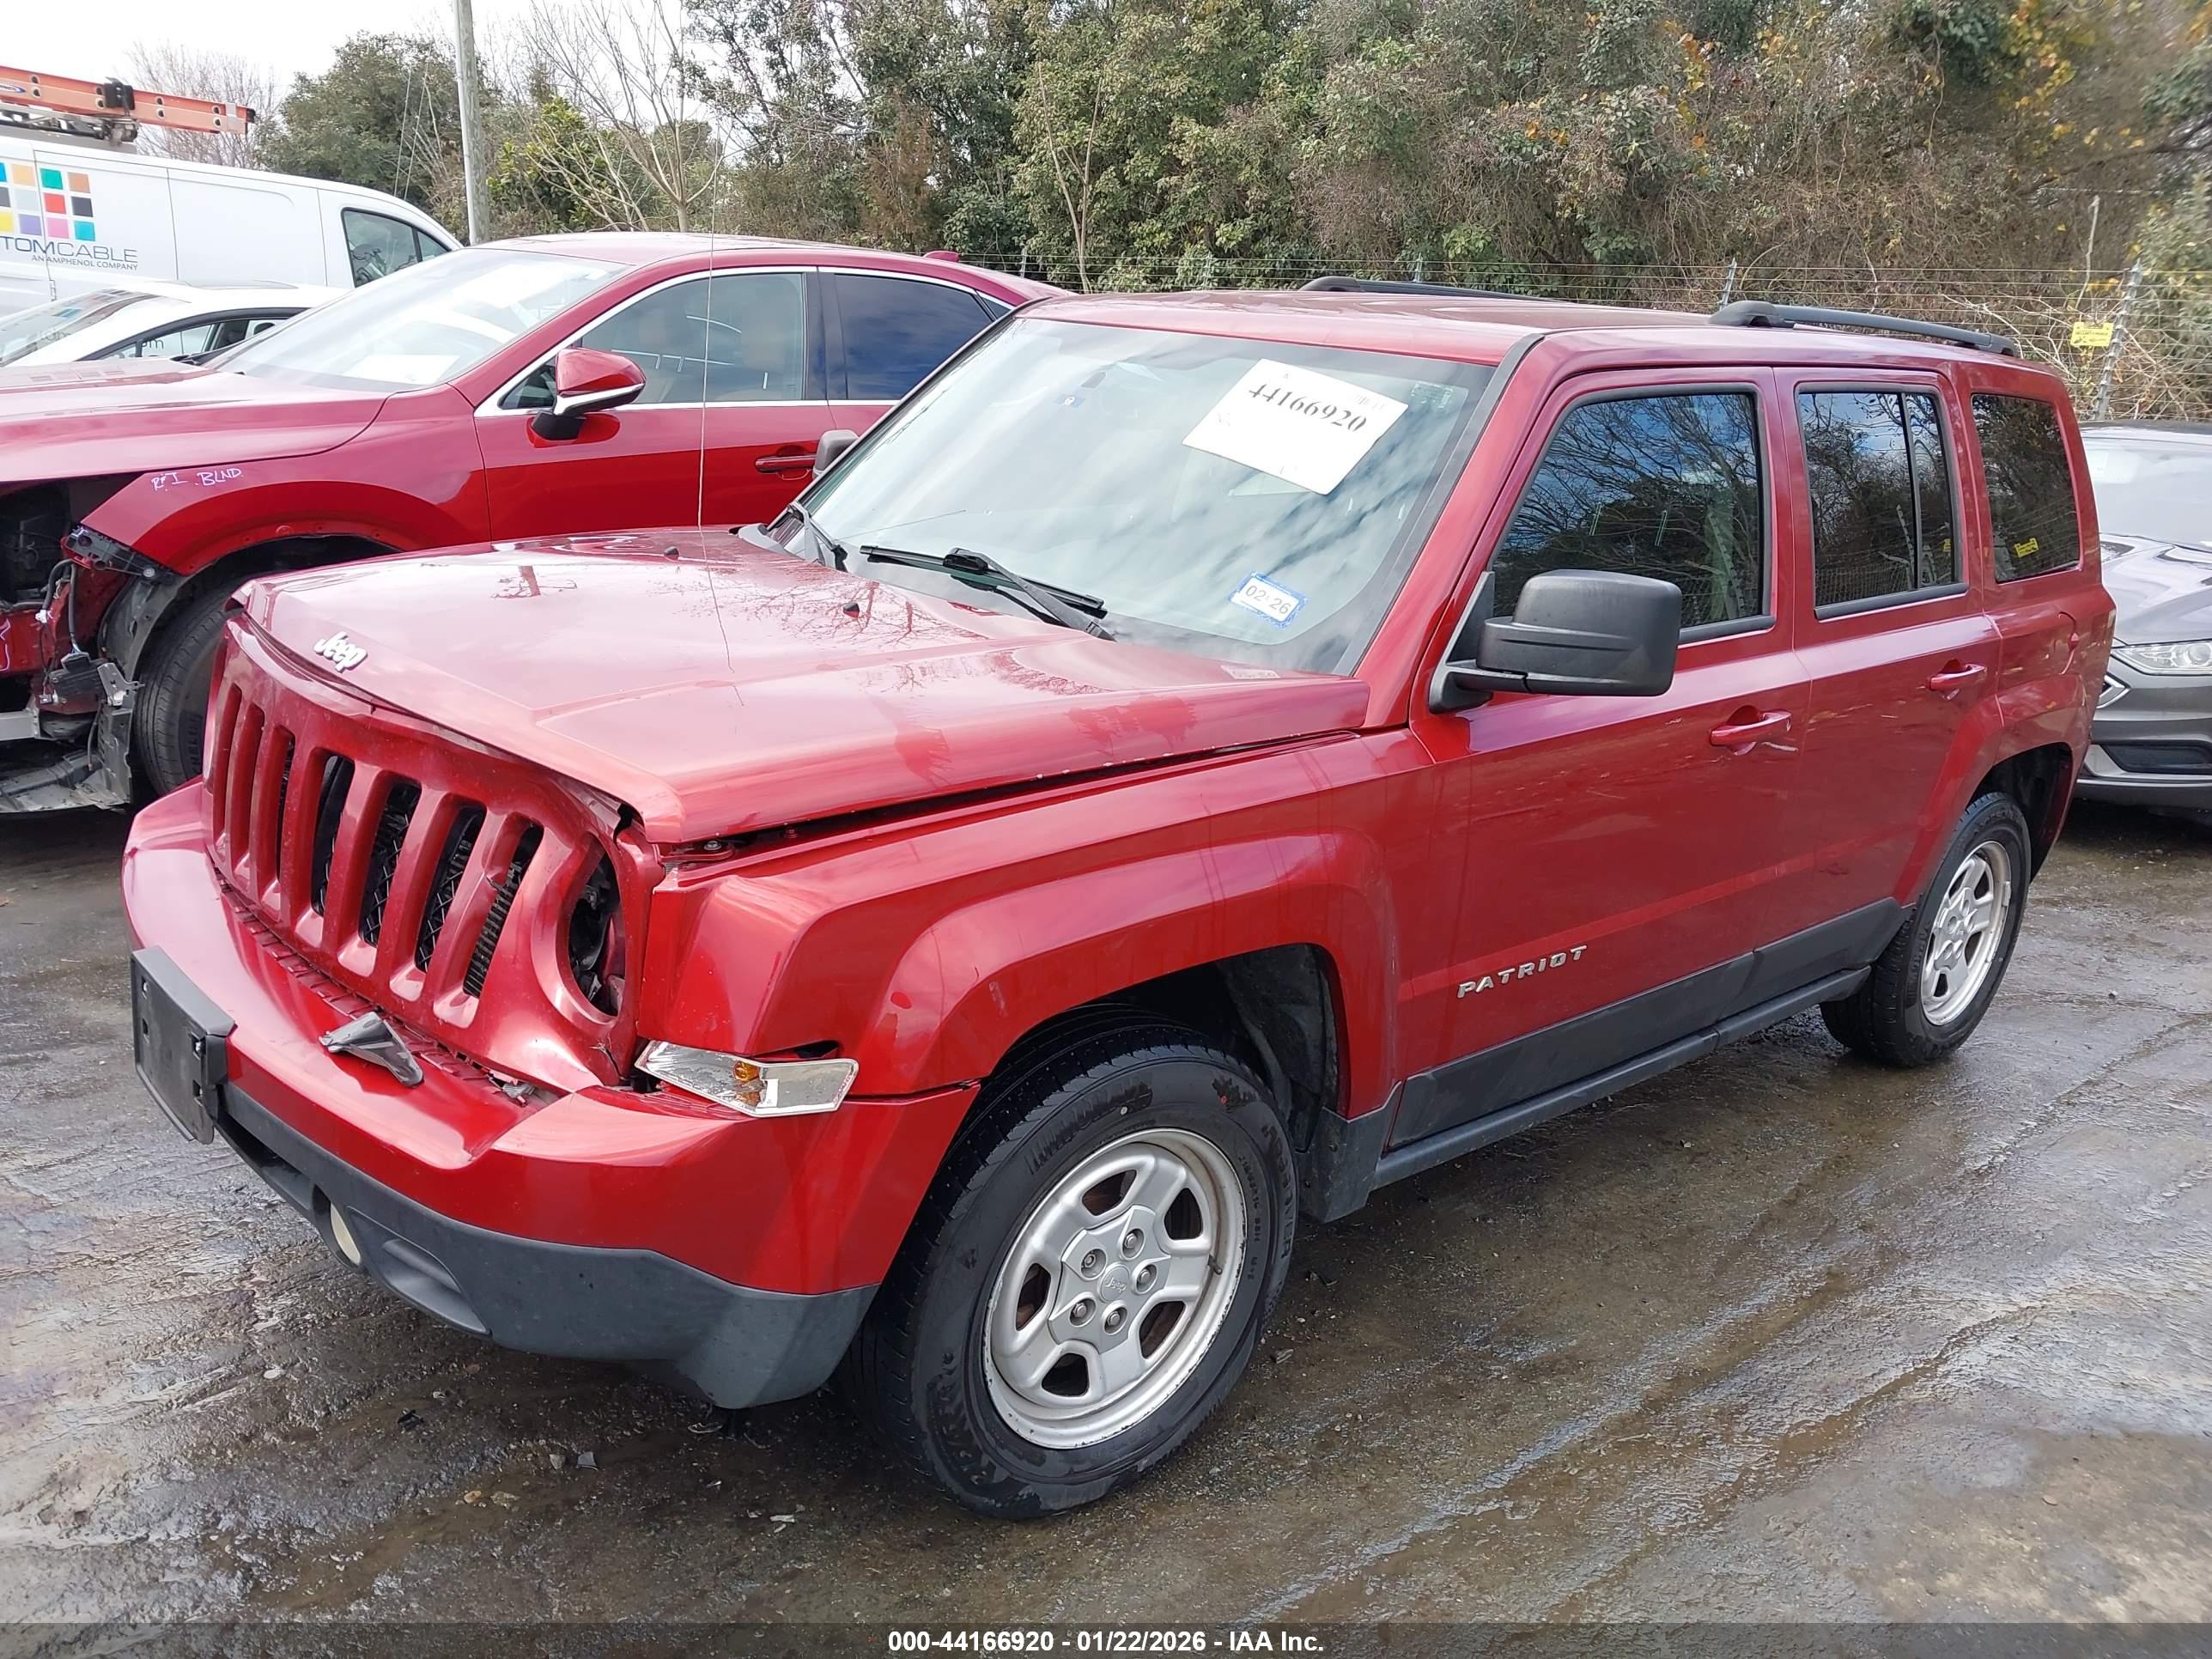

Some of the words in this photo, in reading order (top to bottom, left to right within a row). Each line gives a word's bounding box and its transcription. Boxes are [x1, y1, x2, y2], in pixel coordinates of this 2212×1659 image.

[46, 256, 95, 267] AMPHENOL
[96, 260, 138, 270] COMPANY
[1249, 384, 1367, 432] 44166920
[313, 631, 368, 672] Jeep
[1457, 945, 1588, 999] PATRIOT
